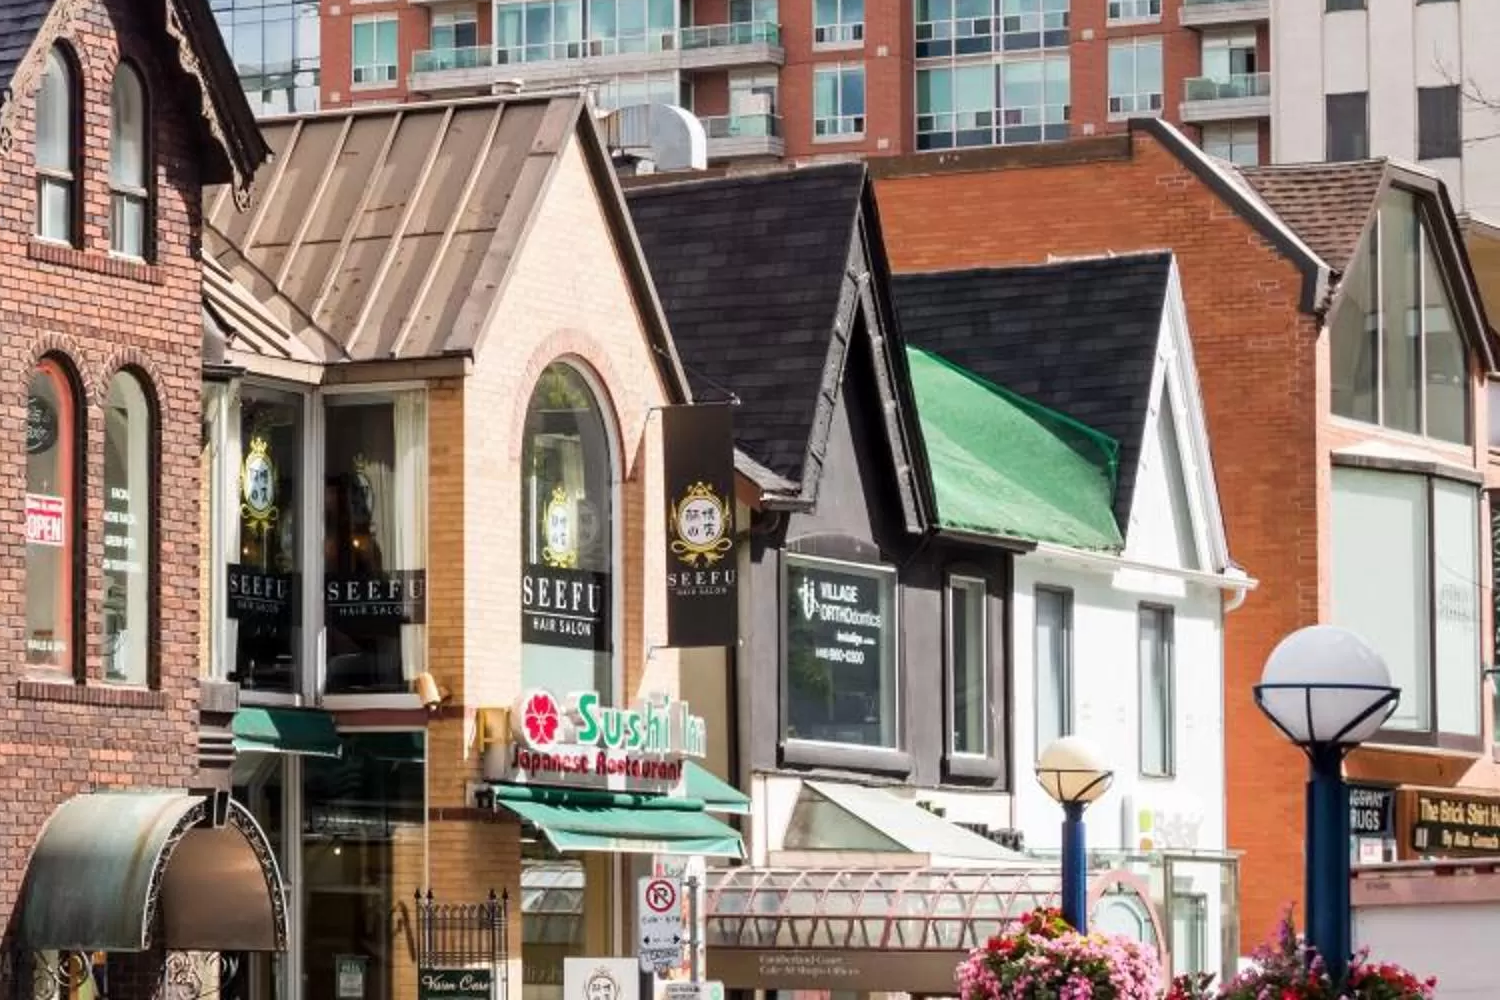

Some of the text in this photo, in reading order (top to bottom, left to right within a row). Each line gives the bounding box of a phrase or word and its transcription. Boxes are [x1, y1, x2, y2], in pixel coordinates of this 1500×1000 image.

[27, 513, 62, 541] OPEN
[229, 573, 288, 599] SEEFU
[326, 577, 425, 601] SEEFU
[667, 569, 736, 587] SEEFU
[523, 575, 601, 613] SEEFU
[820, 581, 859, 603] VILLAGE
[339, 606, 368, 616] HAIR
[533, 617, 591, 636] HAIR SALON
[578, 691, 671, 752] Sushi
[511, 744, 682, 781] Japanese Restaurant
[1420, 797, 1439, 822] The
[1440, 799, 1464, 824] Brick
[1467, 802, 1490, 827] Shirt
